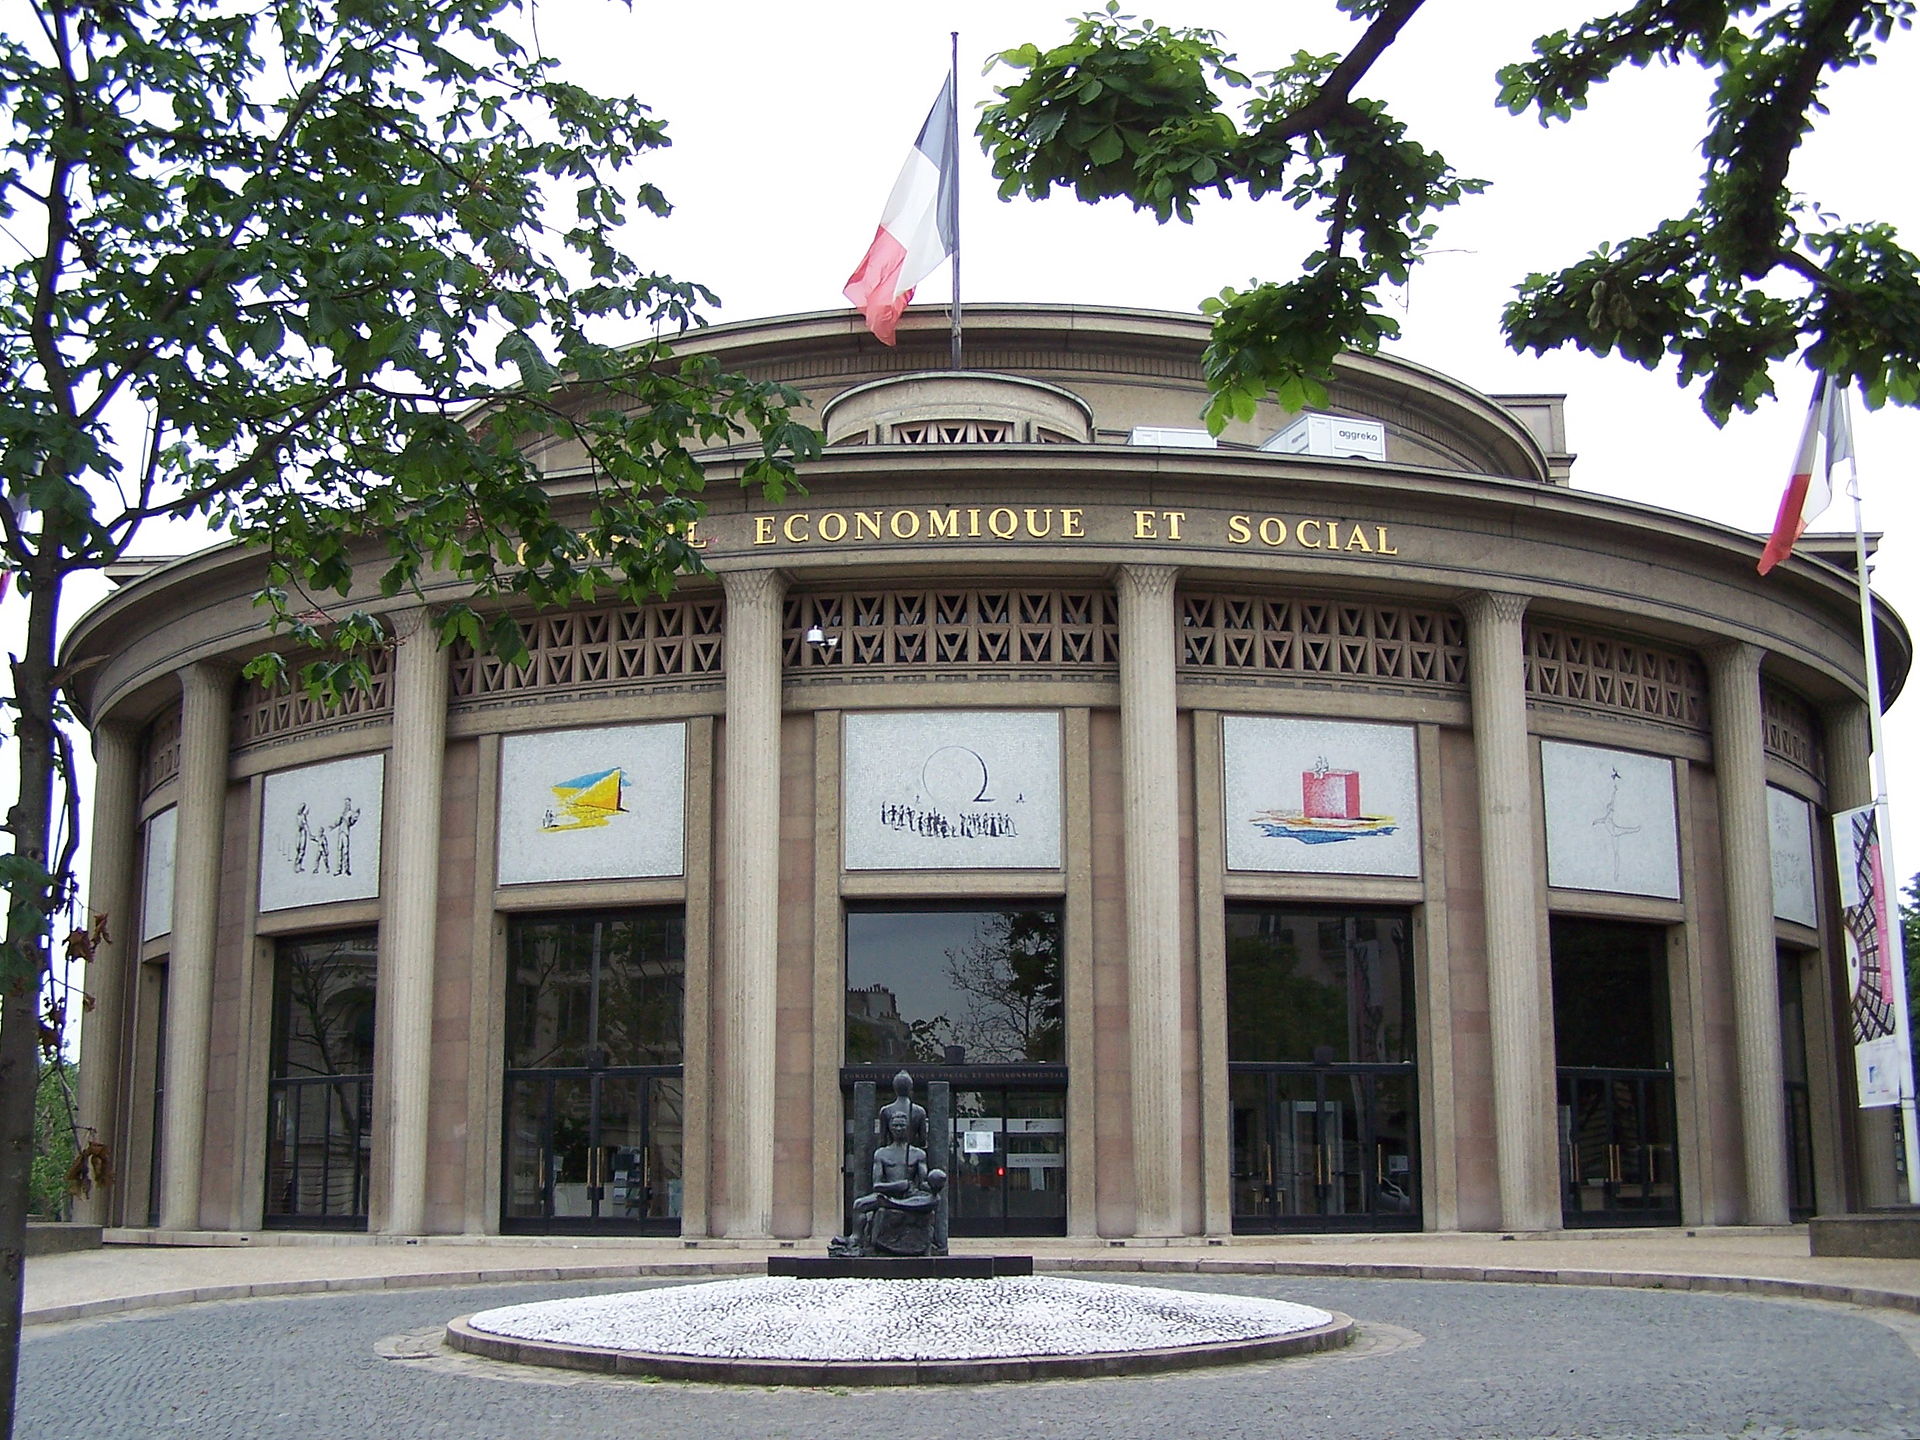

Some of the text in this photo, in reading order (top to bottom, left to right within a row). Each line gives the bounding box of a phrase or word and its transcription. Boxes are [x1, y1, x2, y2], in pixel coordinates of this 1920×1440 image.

[1338, 430, 1378, 442] aggreko
[753, 507, 1086, 545] ECONOMIQUE
[1133, 510, 1186, 541] ET
[1228, 515, 1398, 555] SOCIAL
